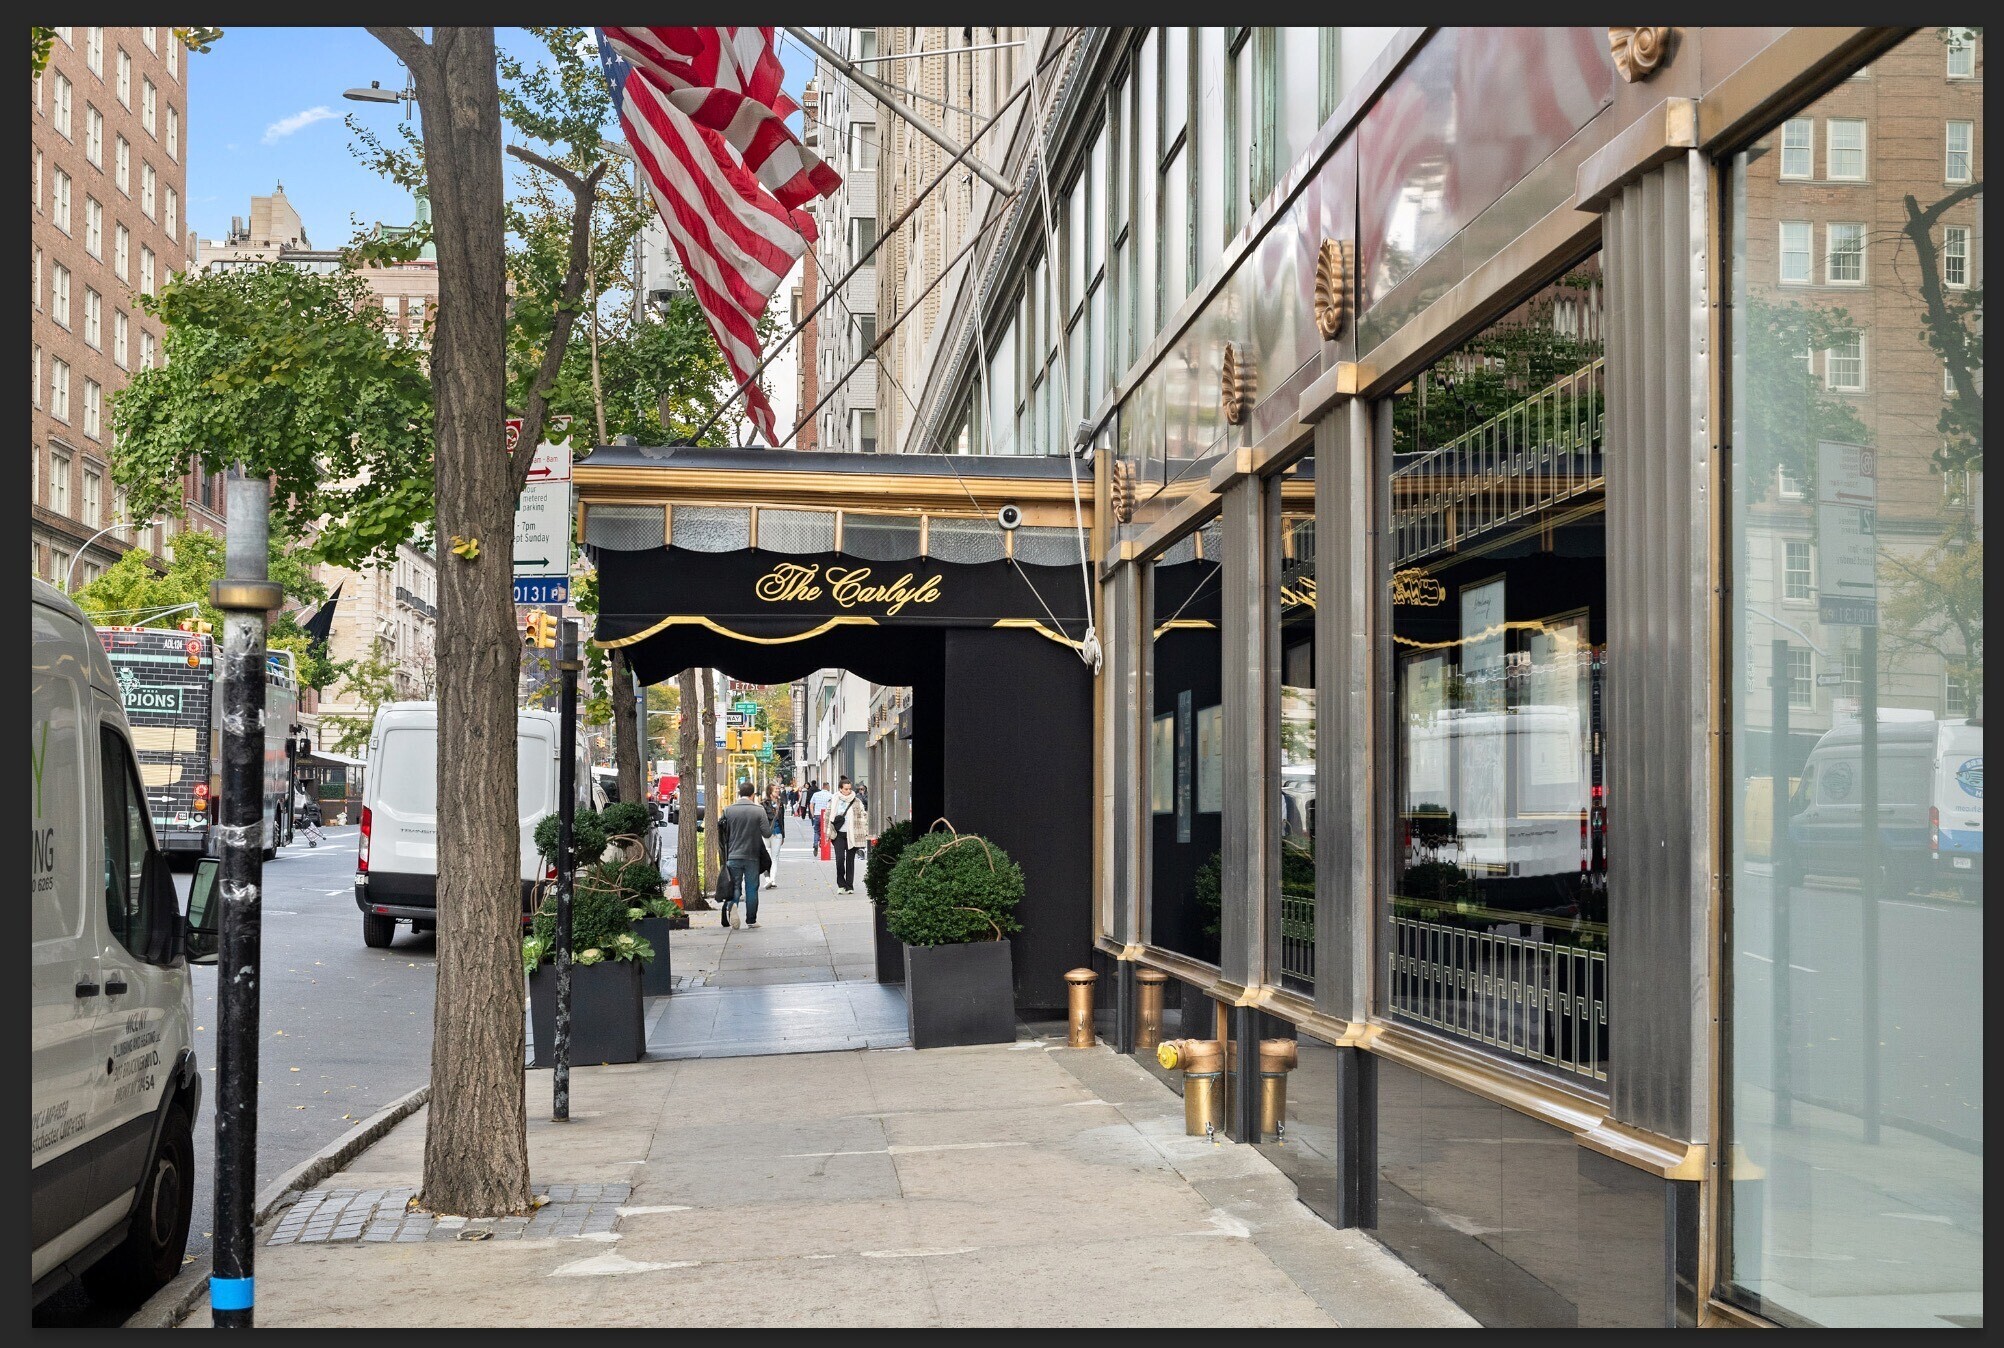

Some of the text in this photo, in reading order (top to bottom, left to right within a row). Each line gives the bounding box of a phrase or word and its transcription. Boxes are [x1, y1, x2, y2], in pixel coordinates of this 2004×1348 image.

[546, 455, 558, 463] 8am
[523, 494, 548, 503] metered
[522, 503, 545, 512] parking
[522, 521, 536, 532] 7pm
[524, 533, 550, 543] Sunday
[755, 562, 943, 616] The Carlyle
[163, 638, 183, 649] ADL124
[124, 693, 176, 707] PIONS
[38, 876, 54, 892] 6265
